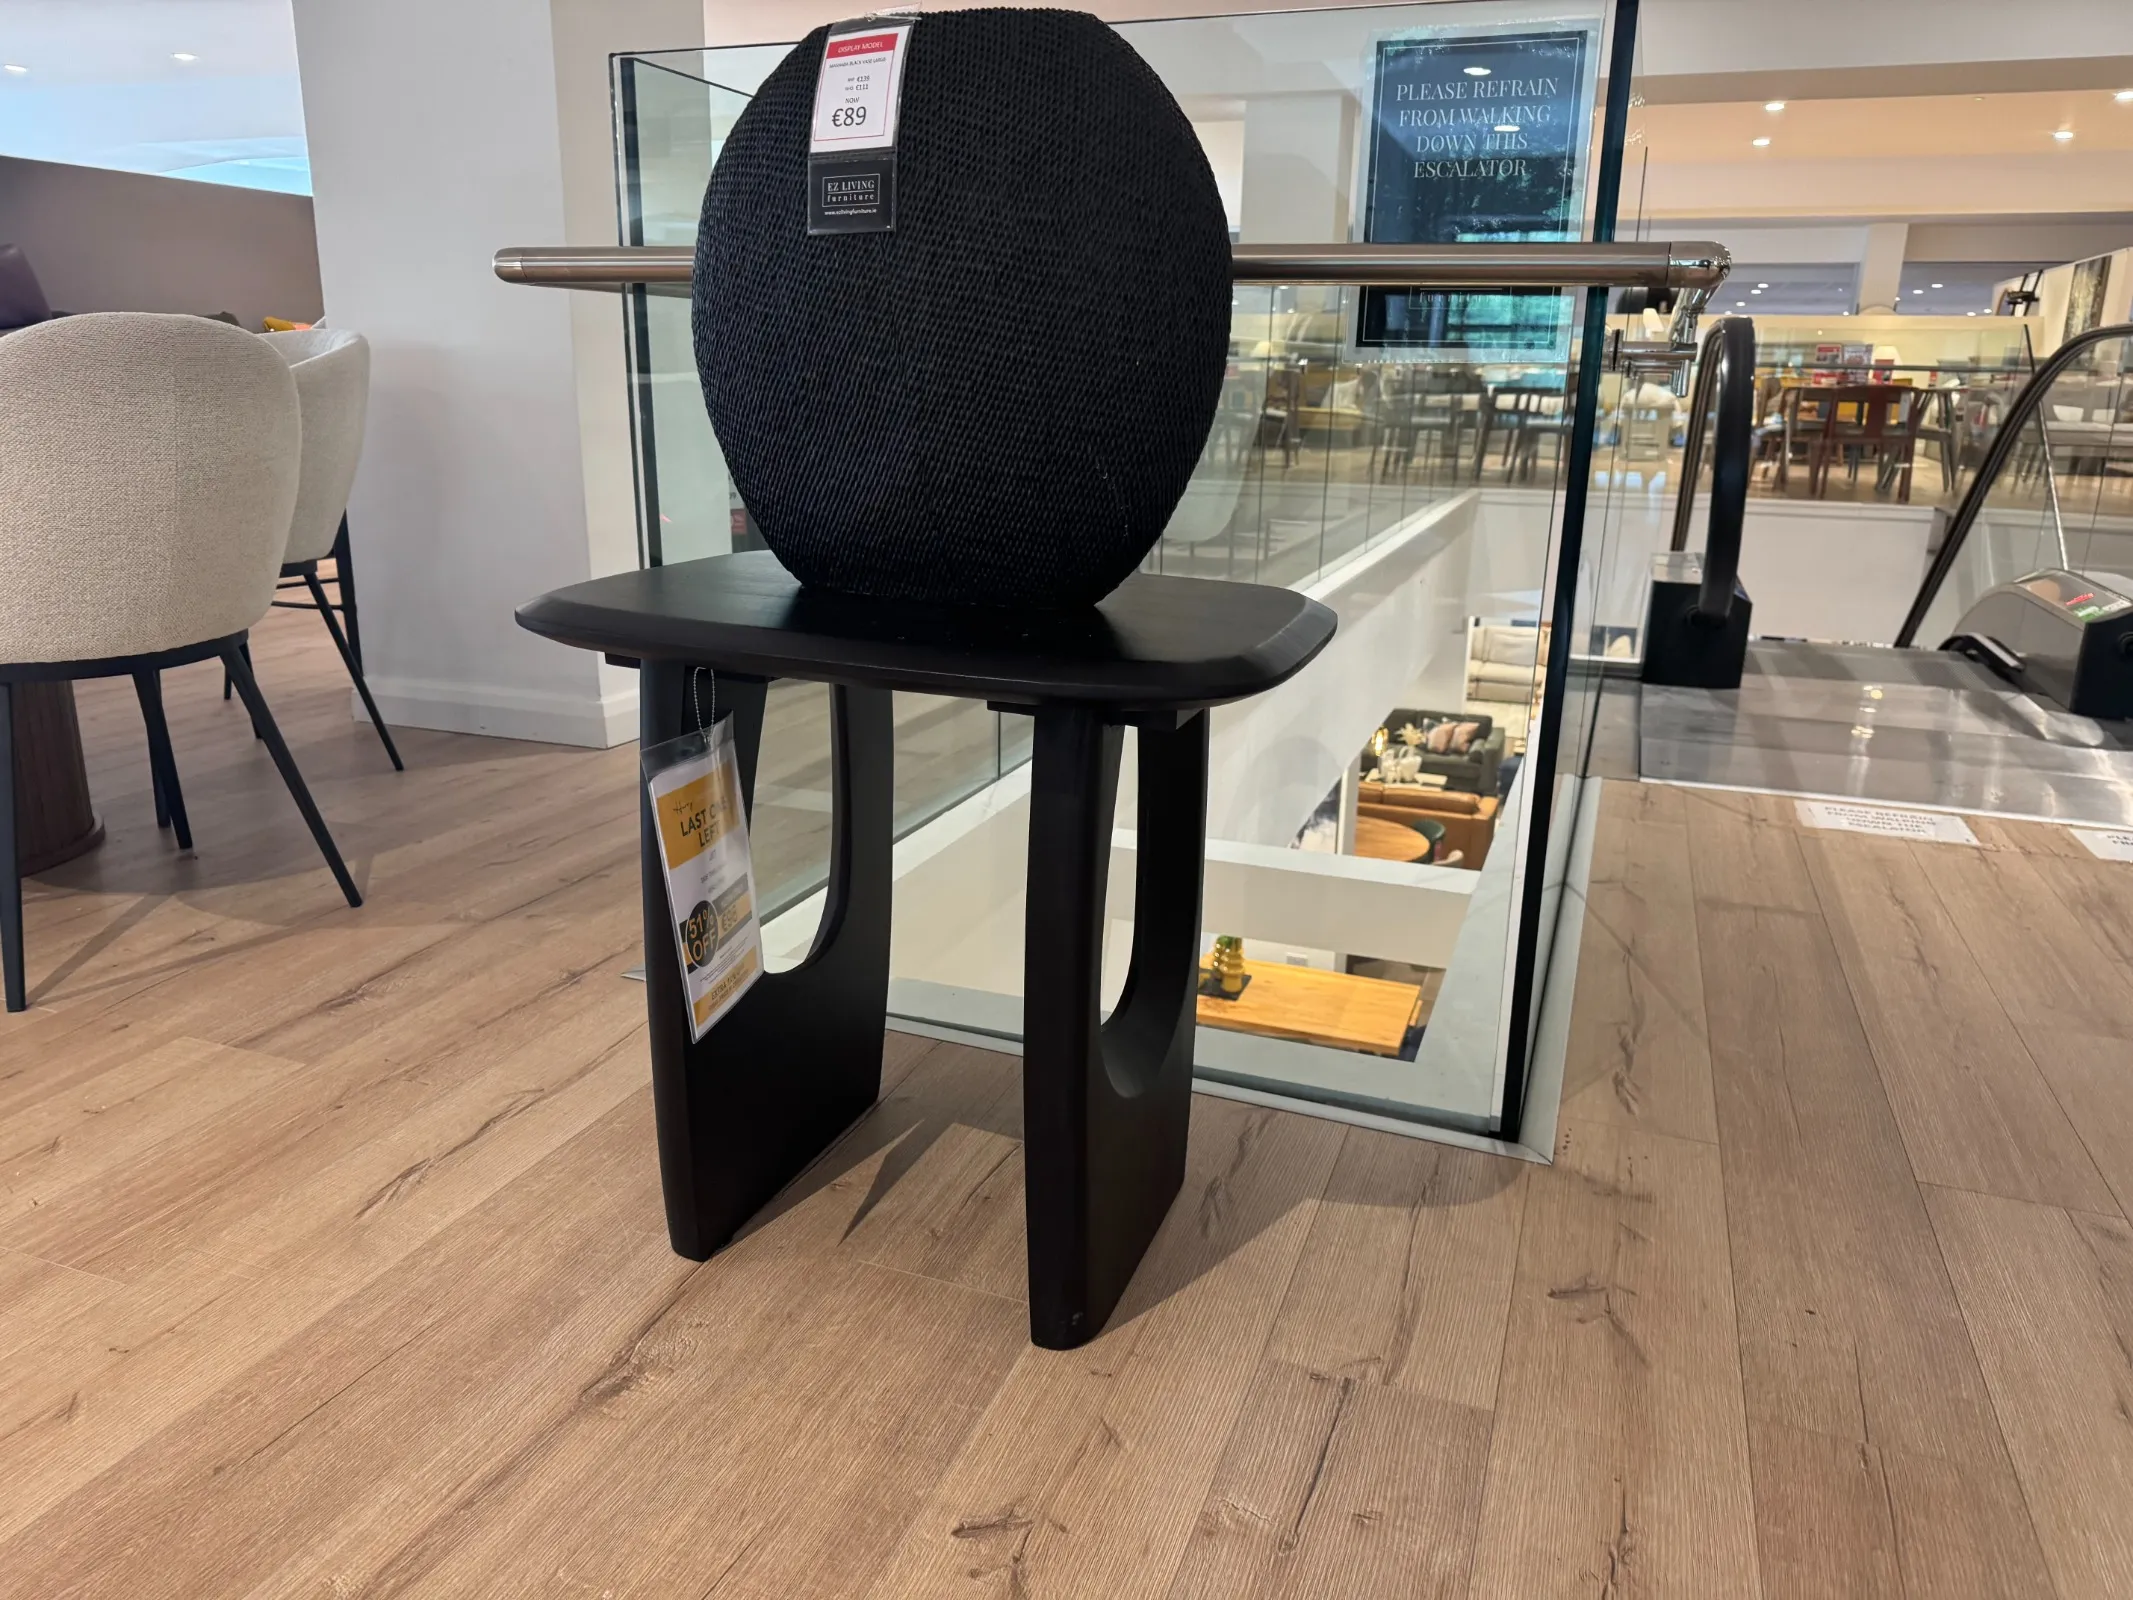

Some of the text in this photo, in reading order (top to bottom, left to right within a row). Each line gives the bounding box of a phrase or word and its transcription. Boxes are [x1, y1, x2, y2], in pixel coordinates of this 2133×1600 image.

[837, 41, 884, 53] DISPLAY MODEL
[845, 96, 860, 104] NOW
[1396, 78, 1559, 101] PLEASE REFRAIN
[831, 106, 867, 127] €89
[1399, 104, 1551, 127] FROM WALKING
[1416, 132, 1528, 152] DOWN THIS
[1413, 159, 1527, 178] ESCALATOR
[827, 180, 875, 192] EZ LIVING
[827, 193, 875, 203] furniture
[680, 807, 707, 837] LAST
[698, 819, 721, 848] LEFT
[687, 910, 715, 939] 51%
[693, 928, 716, 961] OFF
